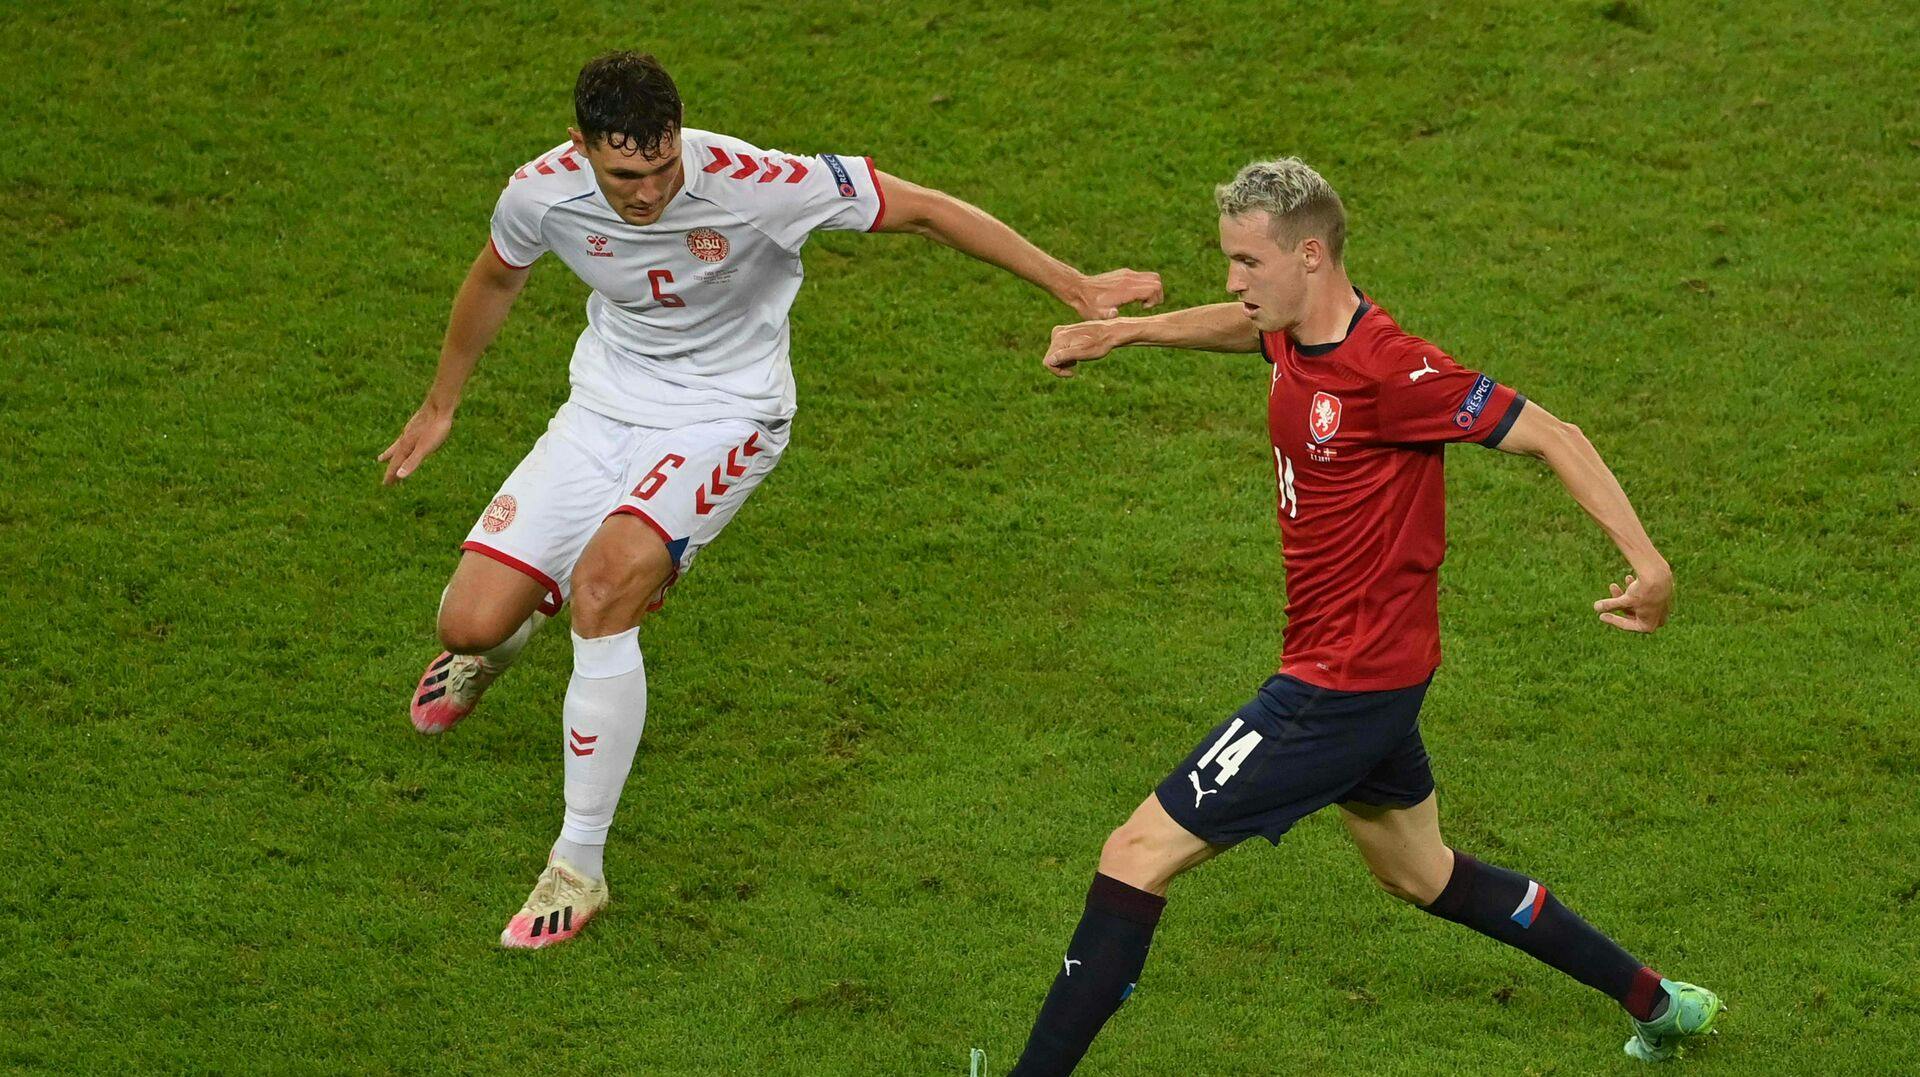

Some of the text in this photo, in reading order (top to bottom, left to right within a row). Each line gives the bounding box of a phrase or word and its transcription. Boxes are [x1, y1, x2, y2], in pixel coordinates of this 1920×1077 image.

[694, 238, 721, 250] DBU
[647, 269, 686, 308] 6
[1466, 376, 1492, 414] RESPECT
[630, 453, 686, 501] 6
[489, 505, 510, 522] DBU
[1197, 717, 1264, 787] 14
